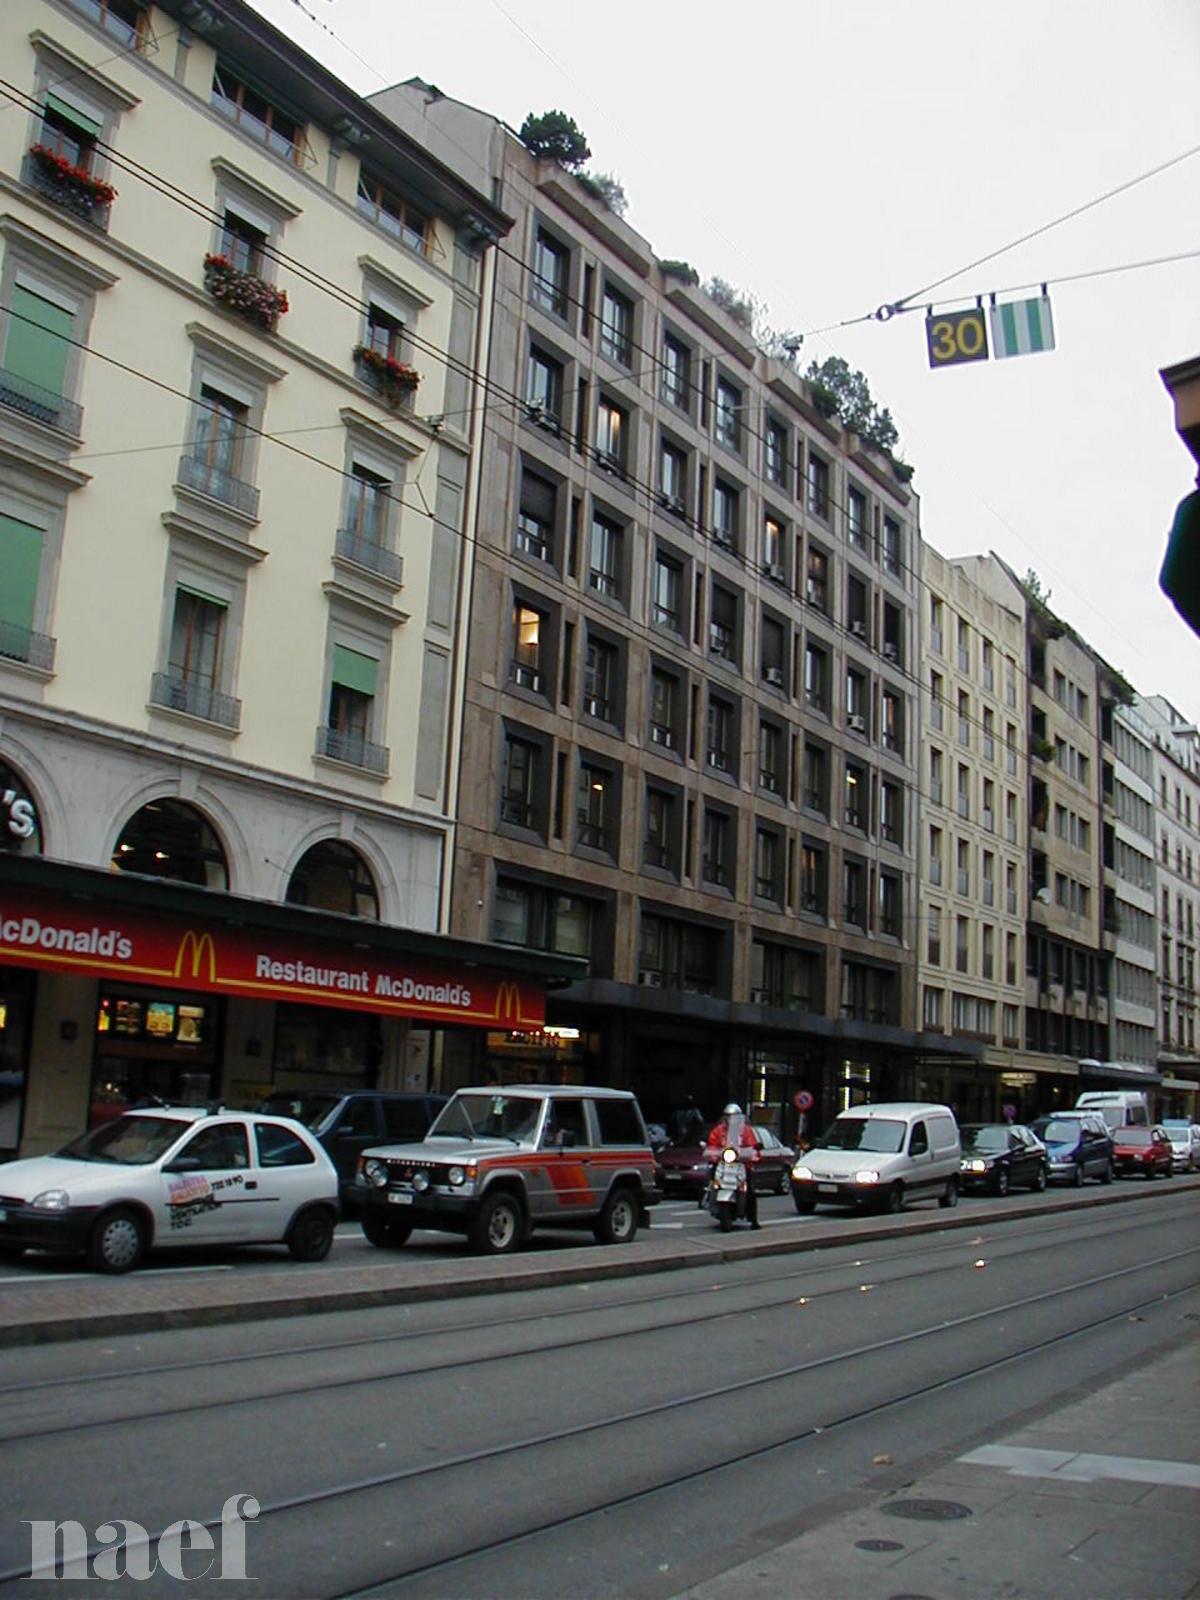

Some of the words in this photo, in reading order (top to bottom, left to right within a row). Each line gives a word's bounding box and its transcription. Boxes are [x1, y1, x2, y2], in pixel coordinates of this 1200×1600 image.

[931, 317, 984, 360] 30
[0, 914, 133, 960] cDonald's
[256, 954, 369, 993] Restaurant
[375, 974, 471, 1007] McDonald's
